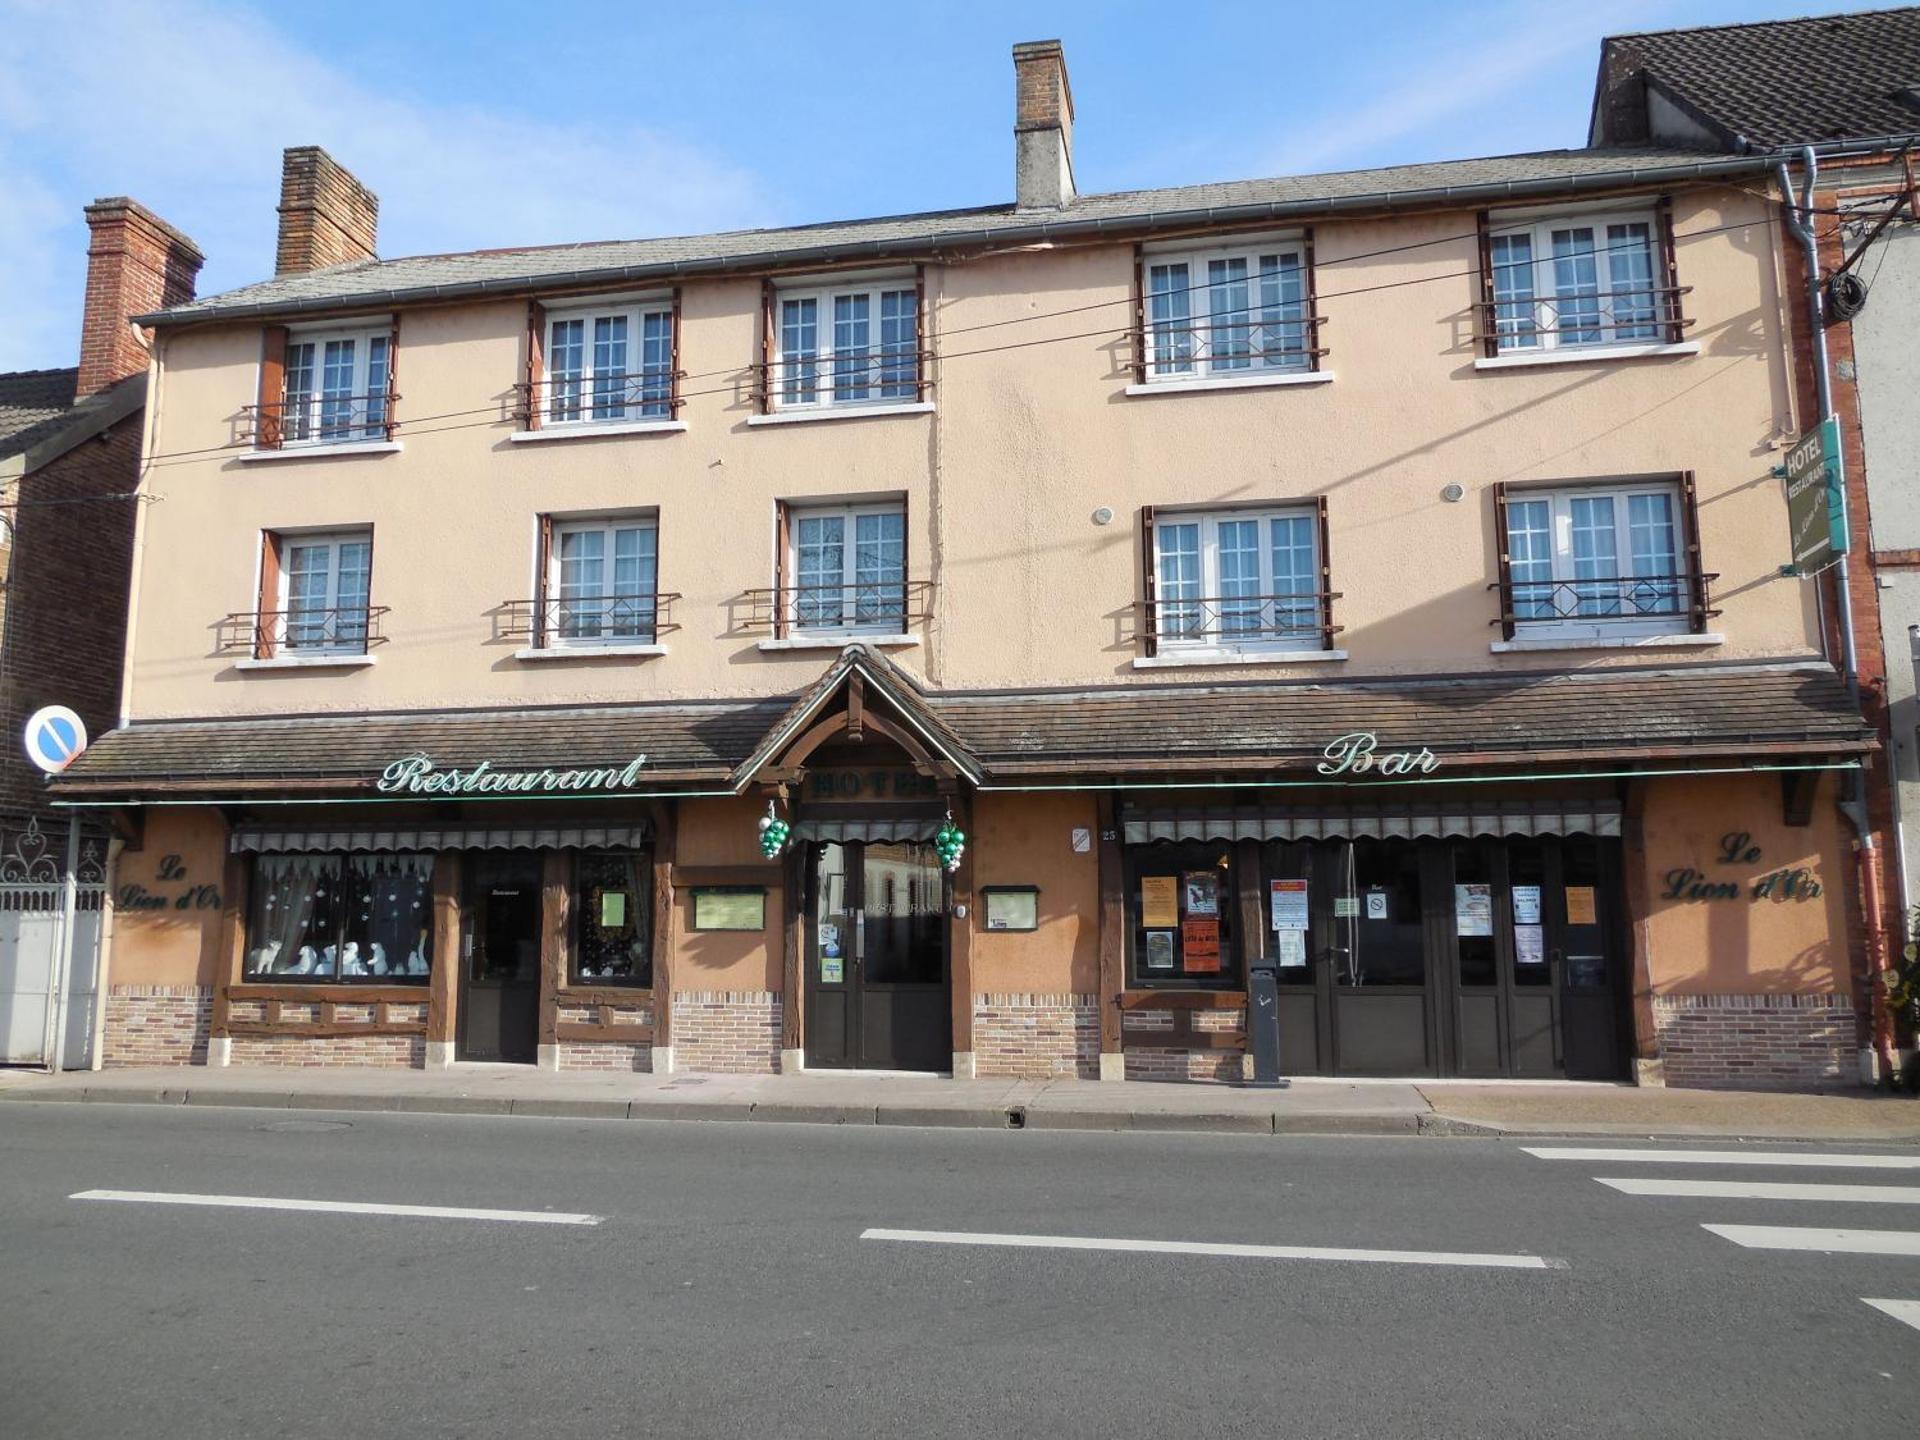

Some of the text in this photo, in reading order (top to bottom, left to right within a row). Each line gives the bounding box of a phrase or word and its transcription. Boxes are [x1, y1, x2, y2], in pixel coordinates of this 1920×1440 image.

[1787, 436, 1822, 477] HOTEL
[1317, 729, 1442, 775] Bar
[376, 751, 647, 794] Restaurant
[1718, 832, 1762, 864] Le
[155, 855, 187, 880] Le
[117, 884, 168, 911] Lion
[1662, 868, 1823, 901] Lion d'Or
